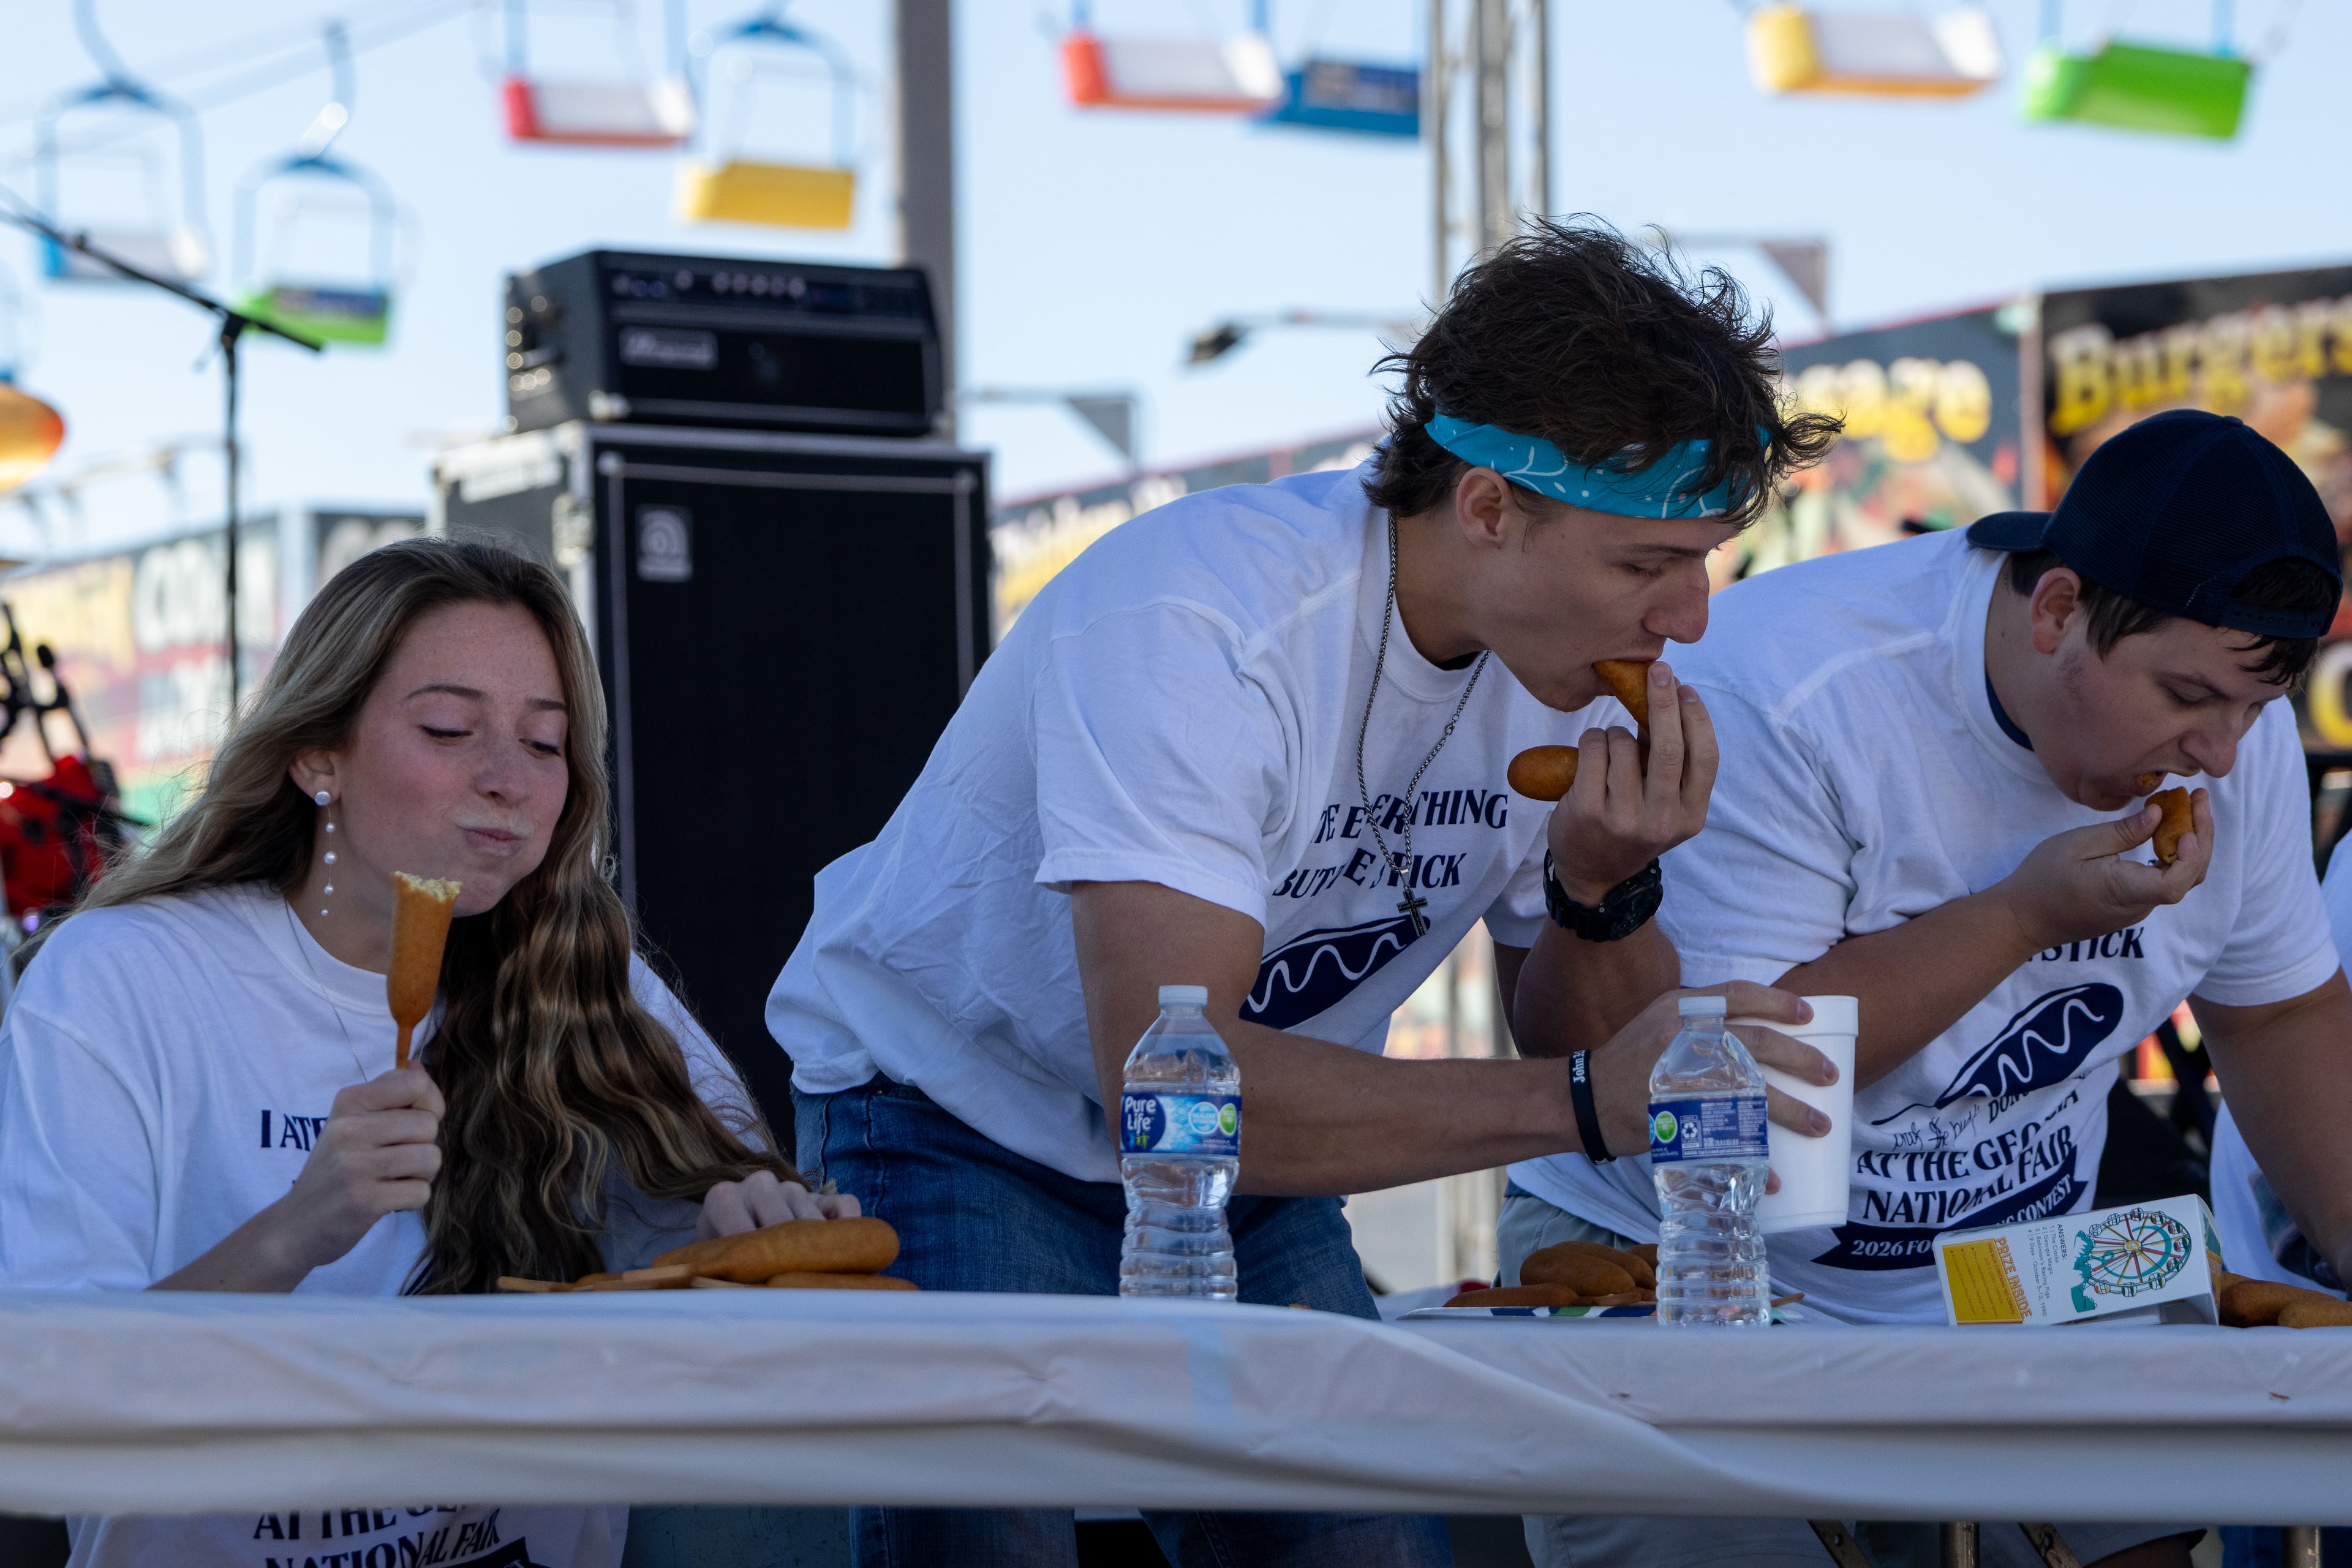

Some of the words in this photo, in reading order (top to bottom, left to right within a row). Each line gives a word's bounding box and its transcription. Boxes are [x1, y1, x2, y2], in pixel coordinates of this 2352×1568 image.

[1311, 804, 1340, 843] TE
[1340, 790, 1508, 839] EERTHING
[1370, 851, 1466, 889] TICK
[1572, 1057, 1585, 1082] John
[1125, 1096, 1156, 1114] Pure
[1127, 1114, 1152, 1134] Life
[261, 1110, 271, 1148] I
[1857, 1150, 1901, 1178] AT
[1902, 1151, 1970, 1182] THE
[1972, 1089, 2078, 1170] GEOIA
[2018, 1125, 2071, 1185] FAIR
[1850, 1240, 1904, 1256] 2026
[1905, 1239, 1933, 1256] FO
[2011, 1174, 2073, 1222] CONTEST
[2043, 1235, 2051, 1256] Georgia
[2057, 1224, 2067, 1259] ANSWERS:
[1994, 1237, 2016, 1273] PRIZE
[2007, 1275, 2032, 1319] INSIDE
[2032, 1261, 2040, 1283] October
